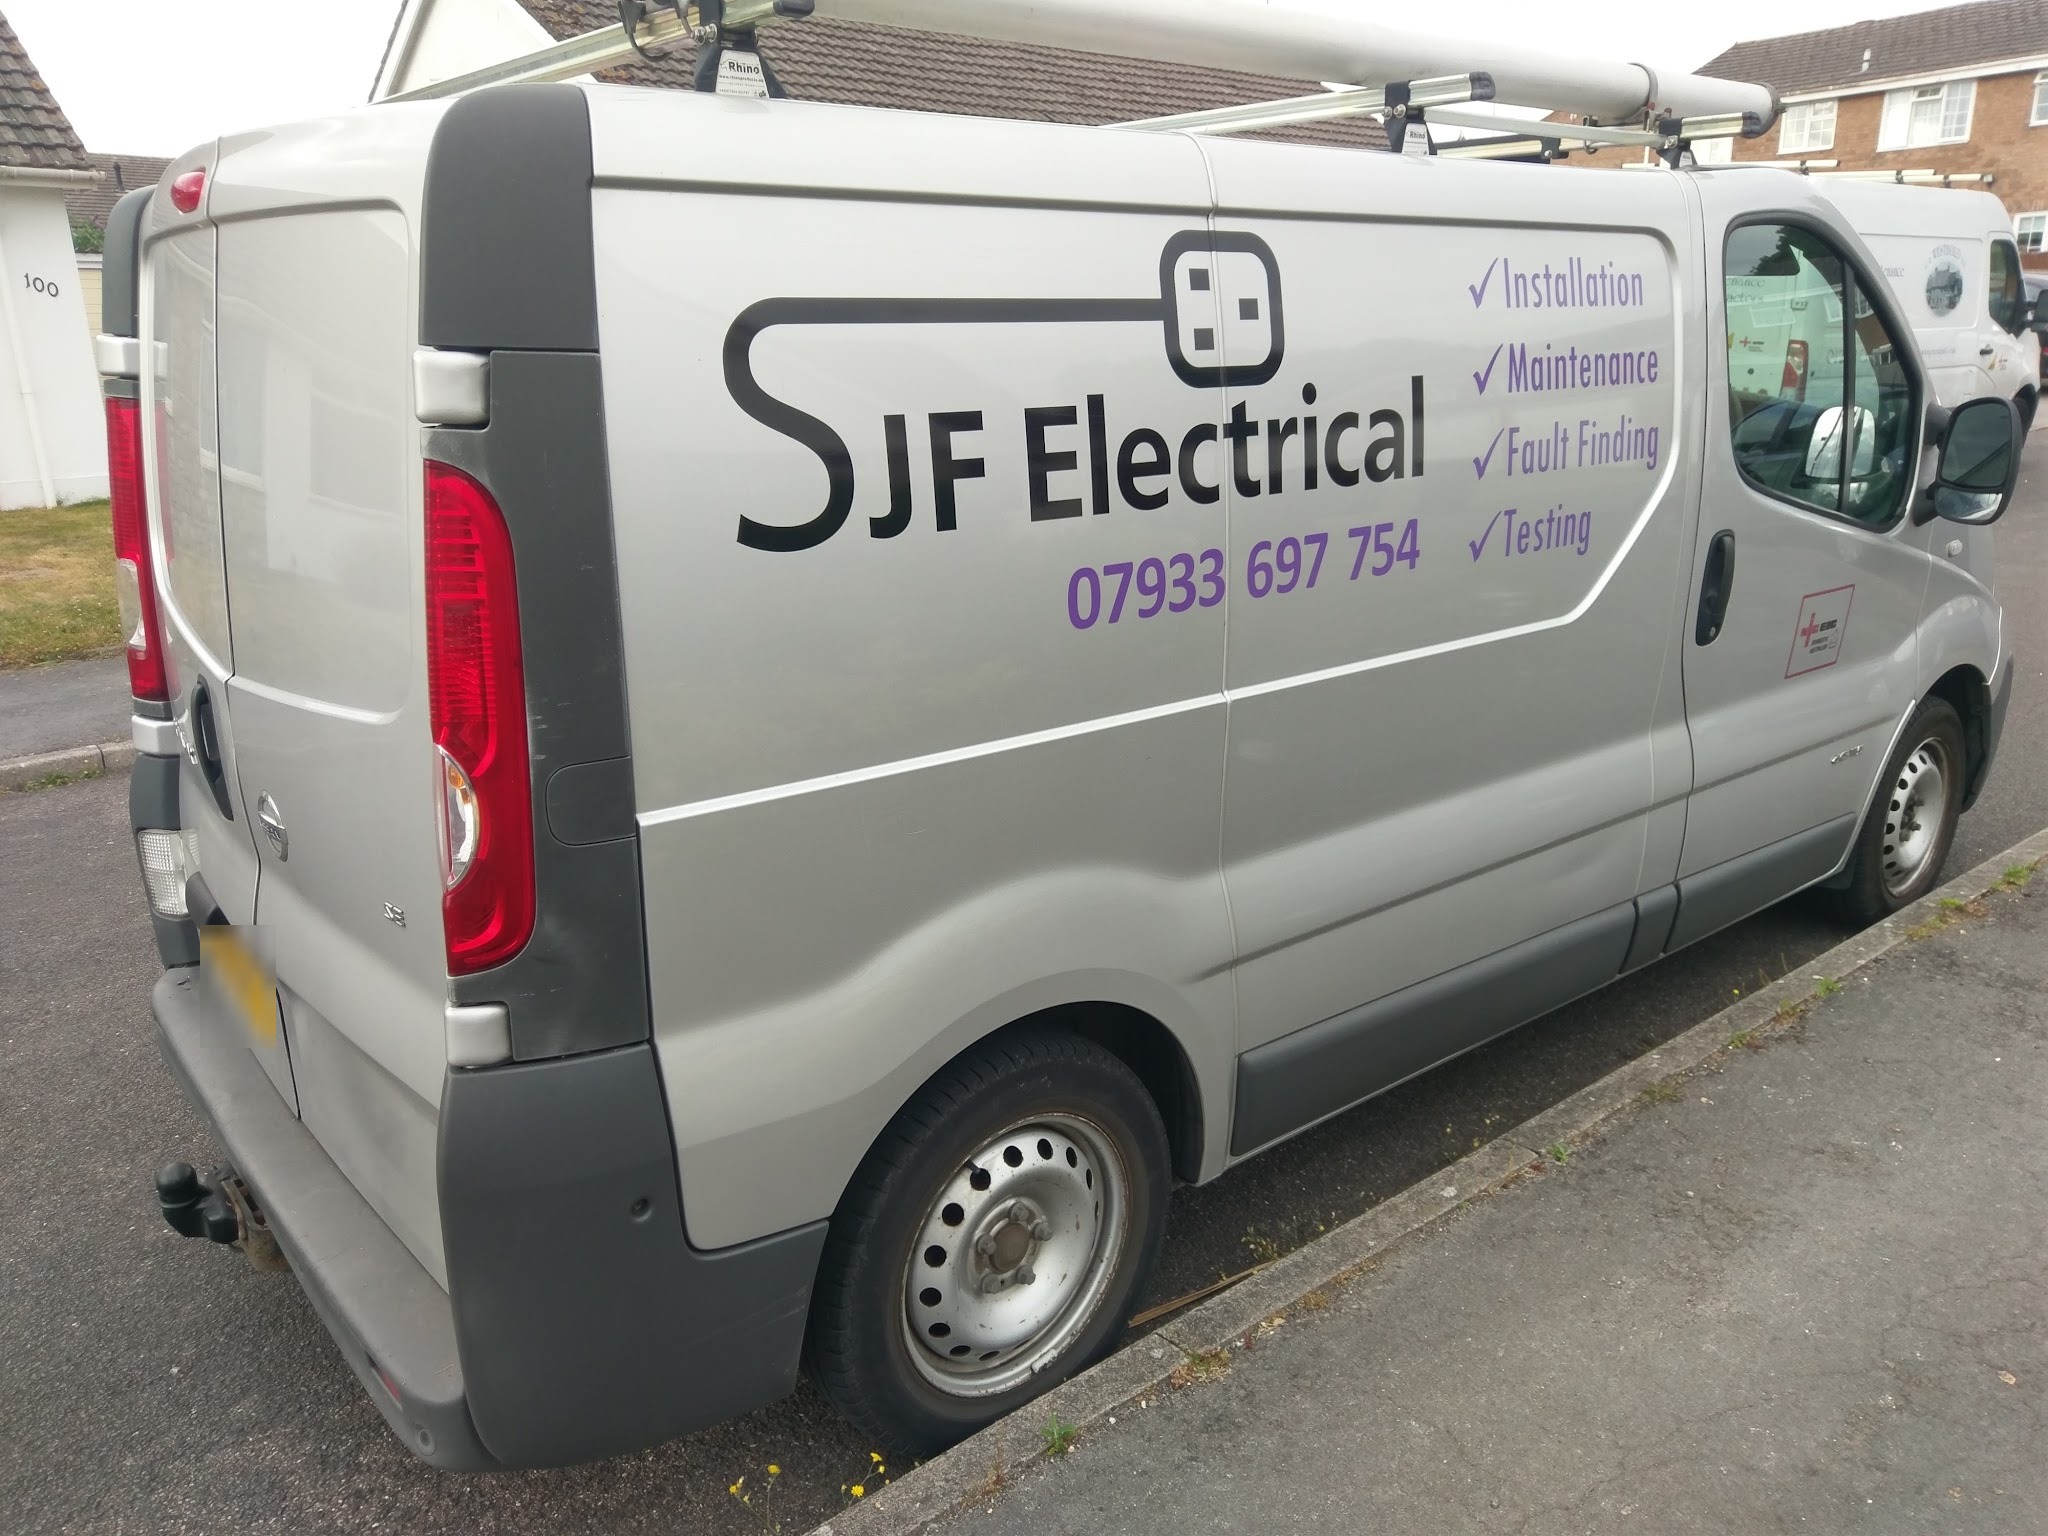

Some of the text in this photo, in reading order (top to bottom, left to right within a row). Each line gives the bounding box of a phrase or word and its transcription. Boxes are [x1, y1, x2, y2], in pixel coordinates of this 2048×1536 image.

[728, 61, 760, 74] Rhino
[1409, 131, 1426, 139] Rhino
[24, 273, 59, 298] 100
[1503, 256, 1643, 308] Installation
[1507, 342, 1658, 394] Maintenance
[723, 297, 1424, 553] SJF Electrical
[1507, 414, 1659, 476] Fault Finding
[1503, 504, 1591, 557] Testing
[1067, 518, 1420, 629] 07933 697 754
